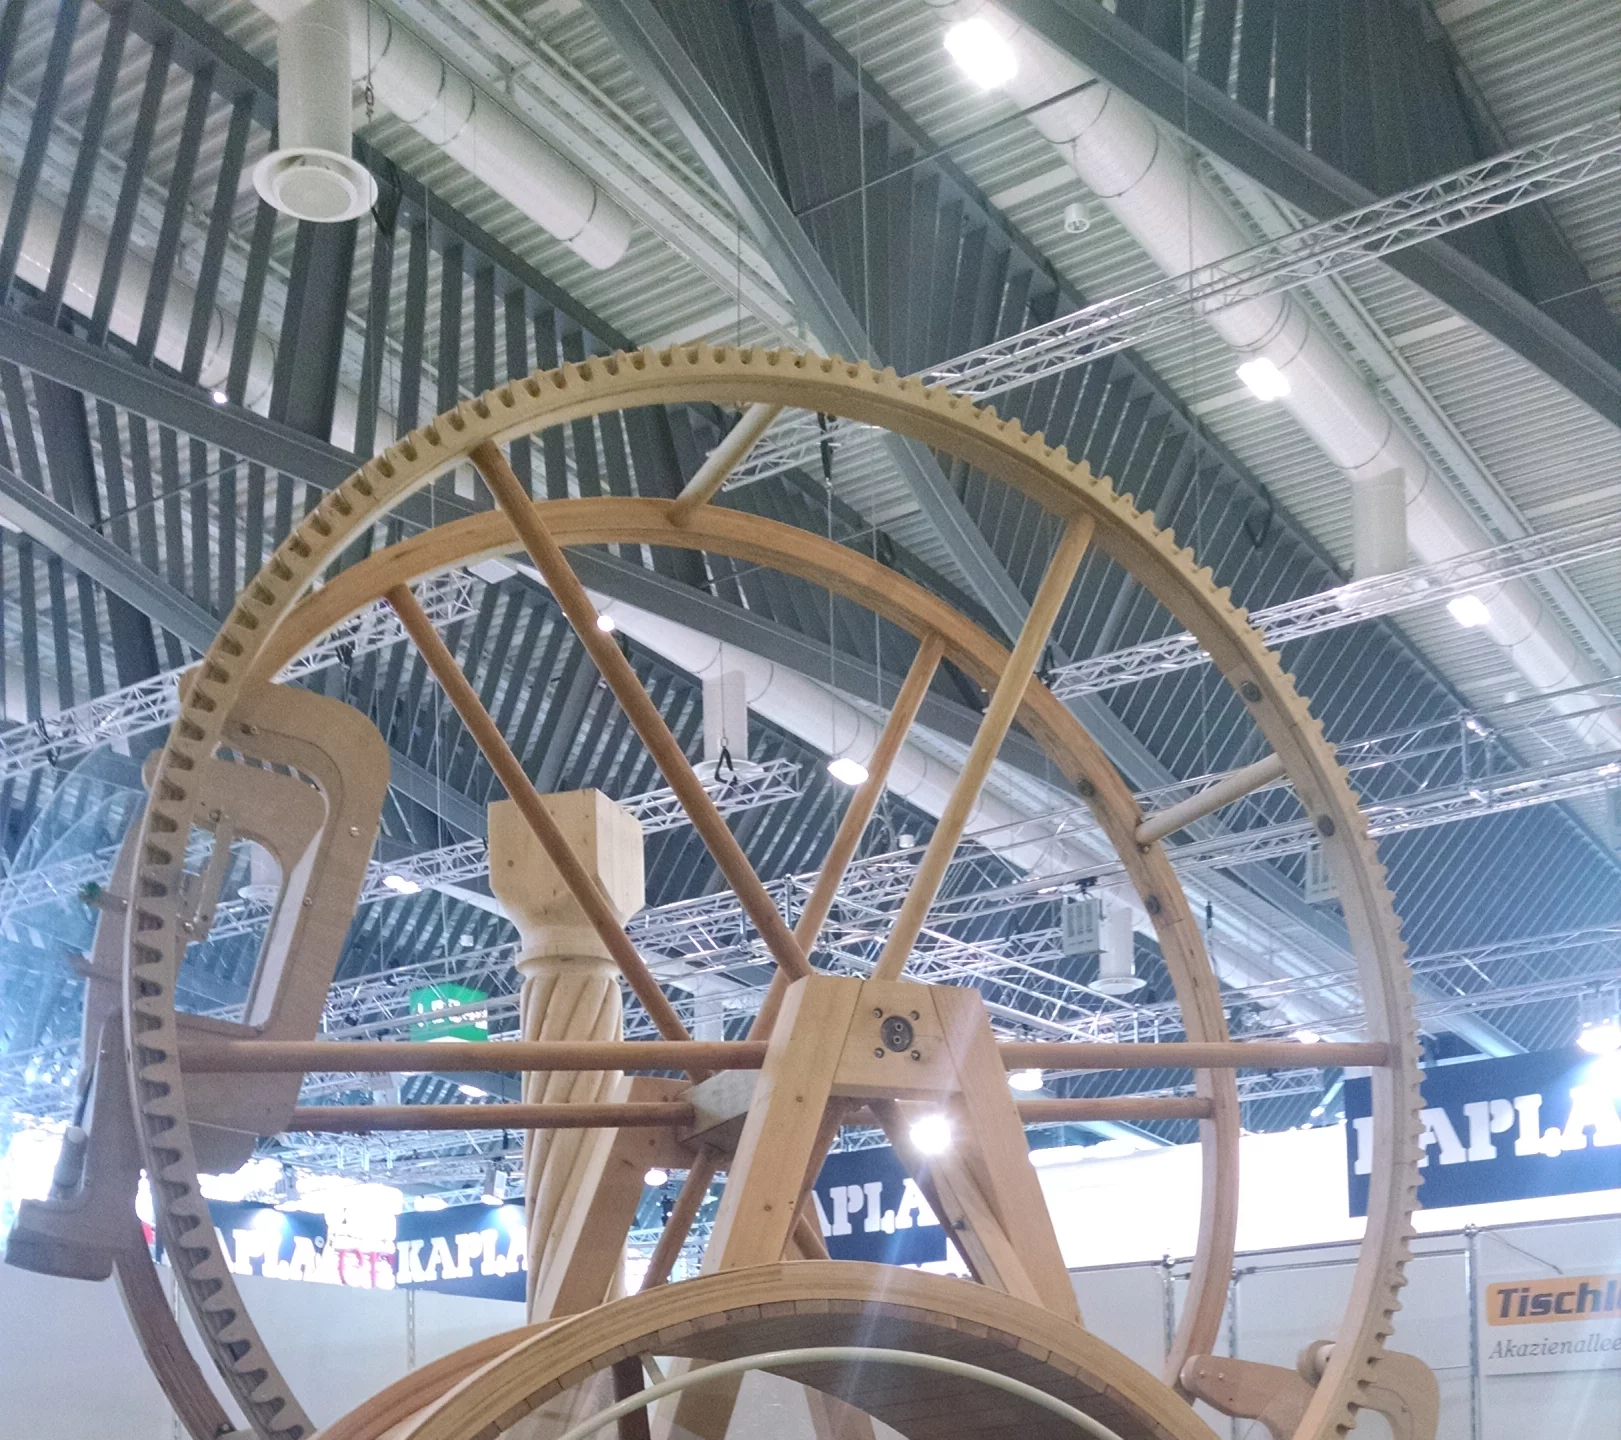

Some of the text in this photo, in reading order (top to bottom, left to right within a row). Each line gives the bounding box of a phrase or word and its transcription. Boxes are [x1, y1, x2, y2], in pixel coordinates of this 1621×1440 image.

[812, 1177, 941, 1237] PLA
[396, 1224, 527, 1284] KAPLA
[1497, 1279, 1621, 1319] Tischl
[1488, 1333, 1621, 1360] Akazienallee
